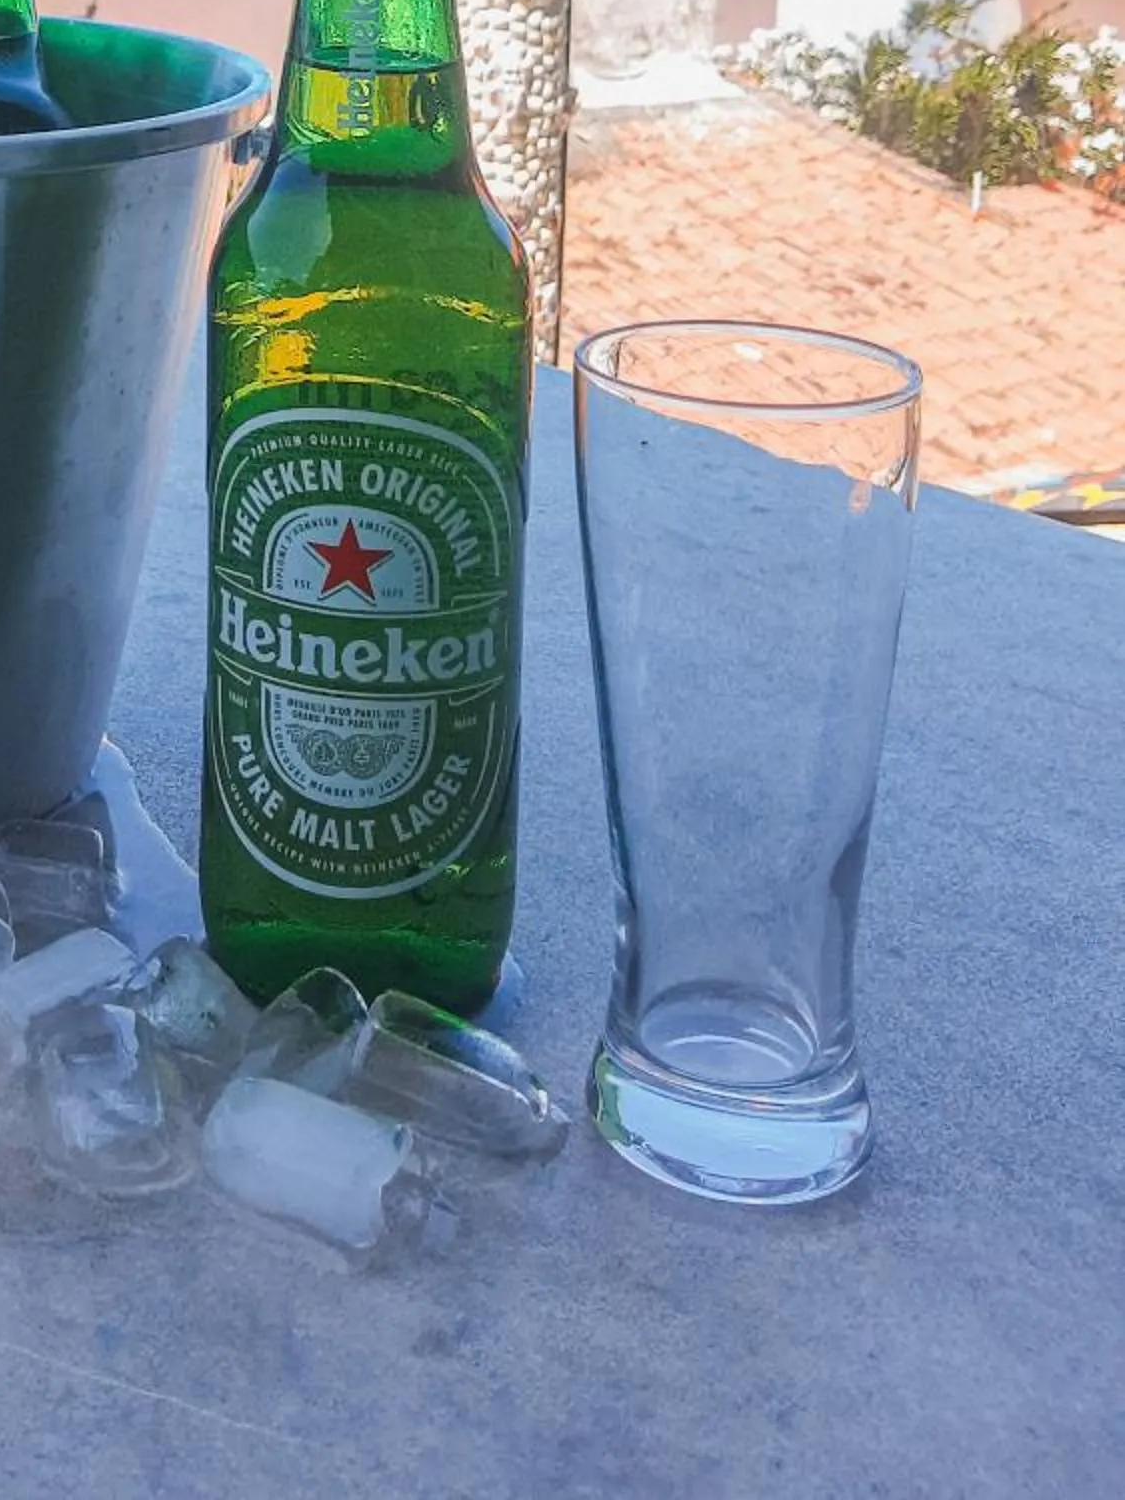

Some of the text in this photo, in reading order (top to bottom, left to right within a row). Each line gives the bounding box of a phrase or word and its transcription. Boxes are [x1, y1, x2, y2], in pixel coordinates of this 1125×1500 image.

[309, 433, 371, 449] QUALITY
[231, 458, 482, 578] HEINEKEN ORIGINAL
[218, 587, 497, 684] Heineken
[231, 733, 473, 851] PURE MALT LAGER
[311, 857, 346, 875] WITH
